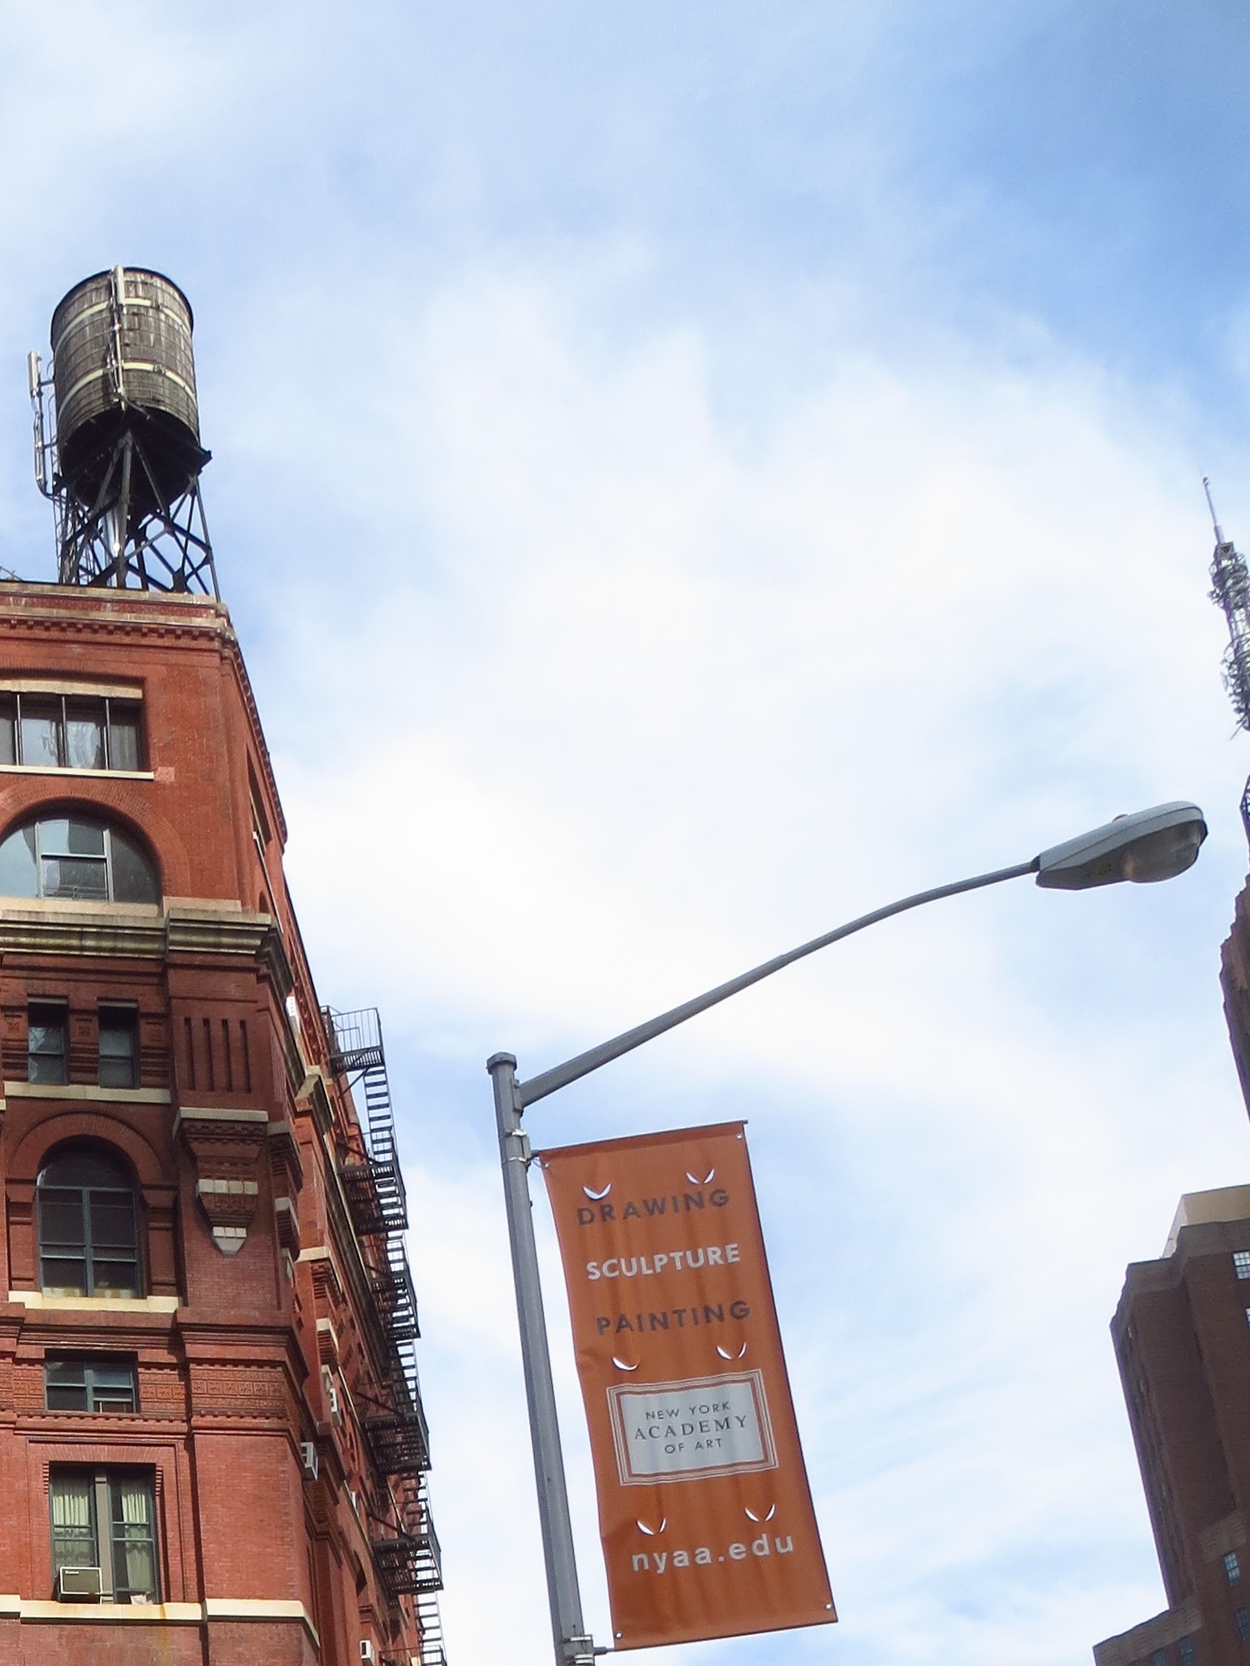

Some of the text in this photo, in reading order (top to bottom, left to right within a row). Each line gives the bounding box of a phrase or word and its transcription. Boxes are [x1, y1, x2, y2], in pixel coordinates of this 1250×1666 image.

[577, 1188, 731, 1227] DRAWING
[587, 1242, 741, 1281] SCULPTURE
[596, 1299, 751, 1336] PAINTING
[634, 1414, 749, 1441] ACADEMY
[645, 1400, 732, 1421] NEW YORK
[664, 1436, 724, 1456] OF ART
[631, 1532, 796, 1574] nyaa.edu
